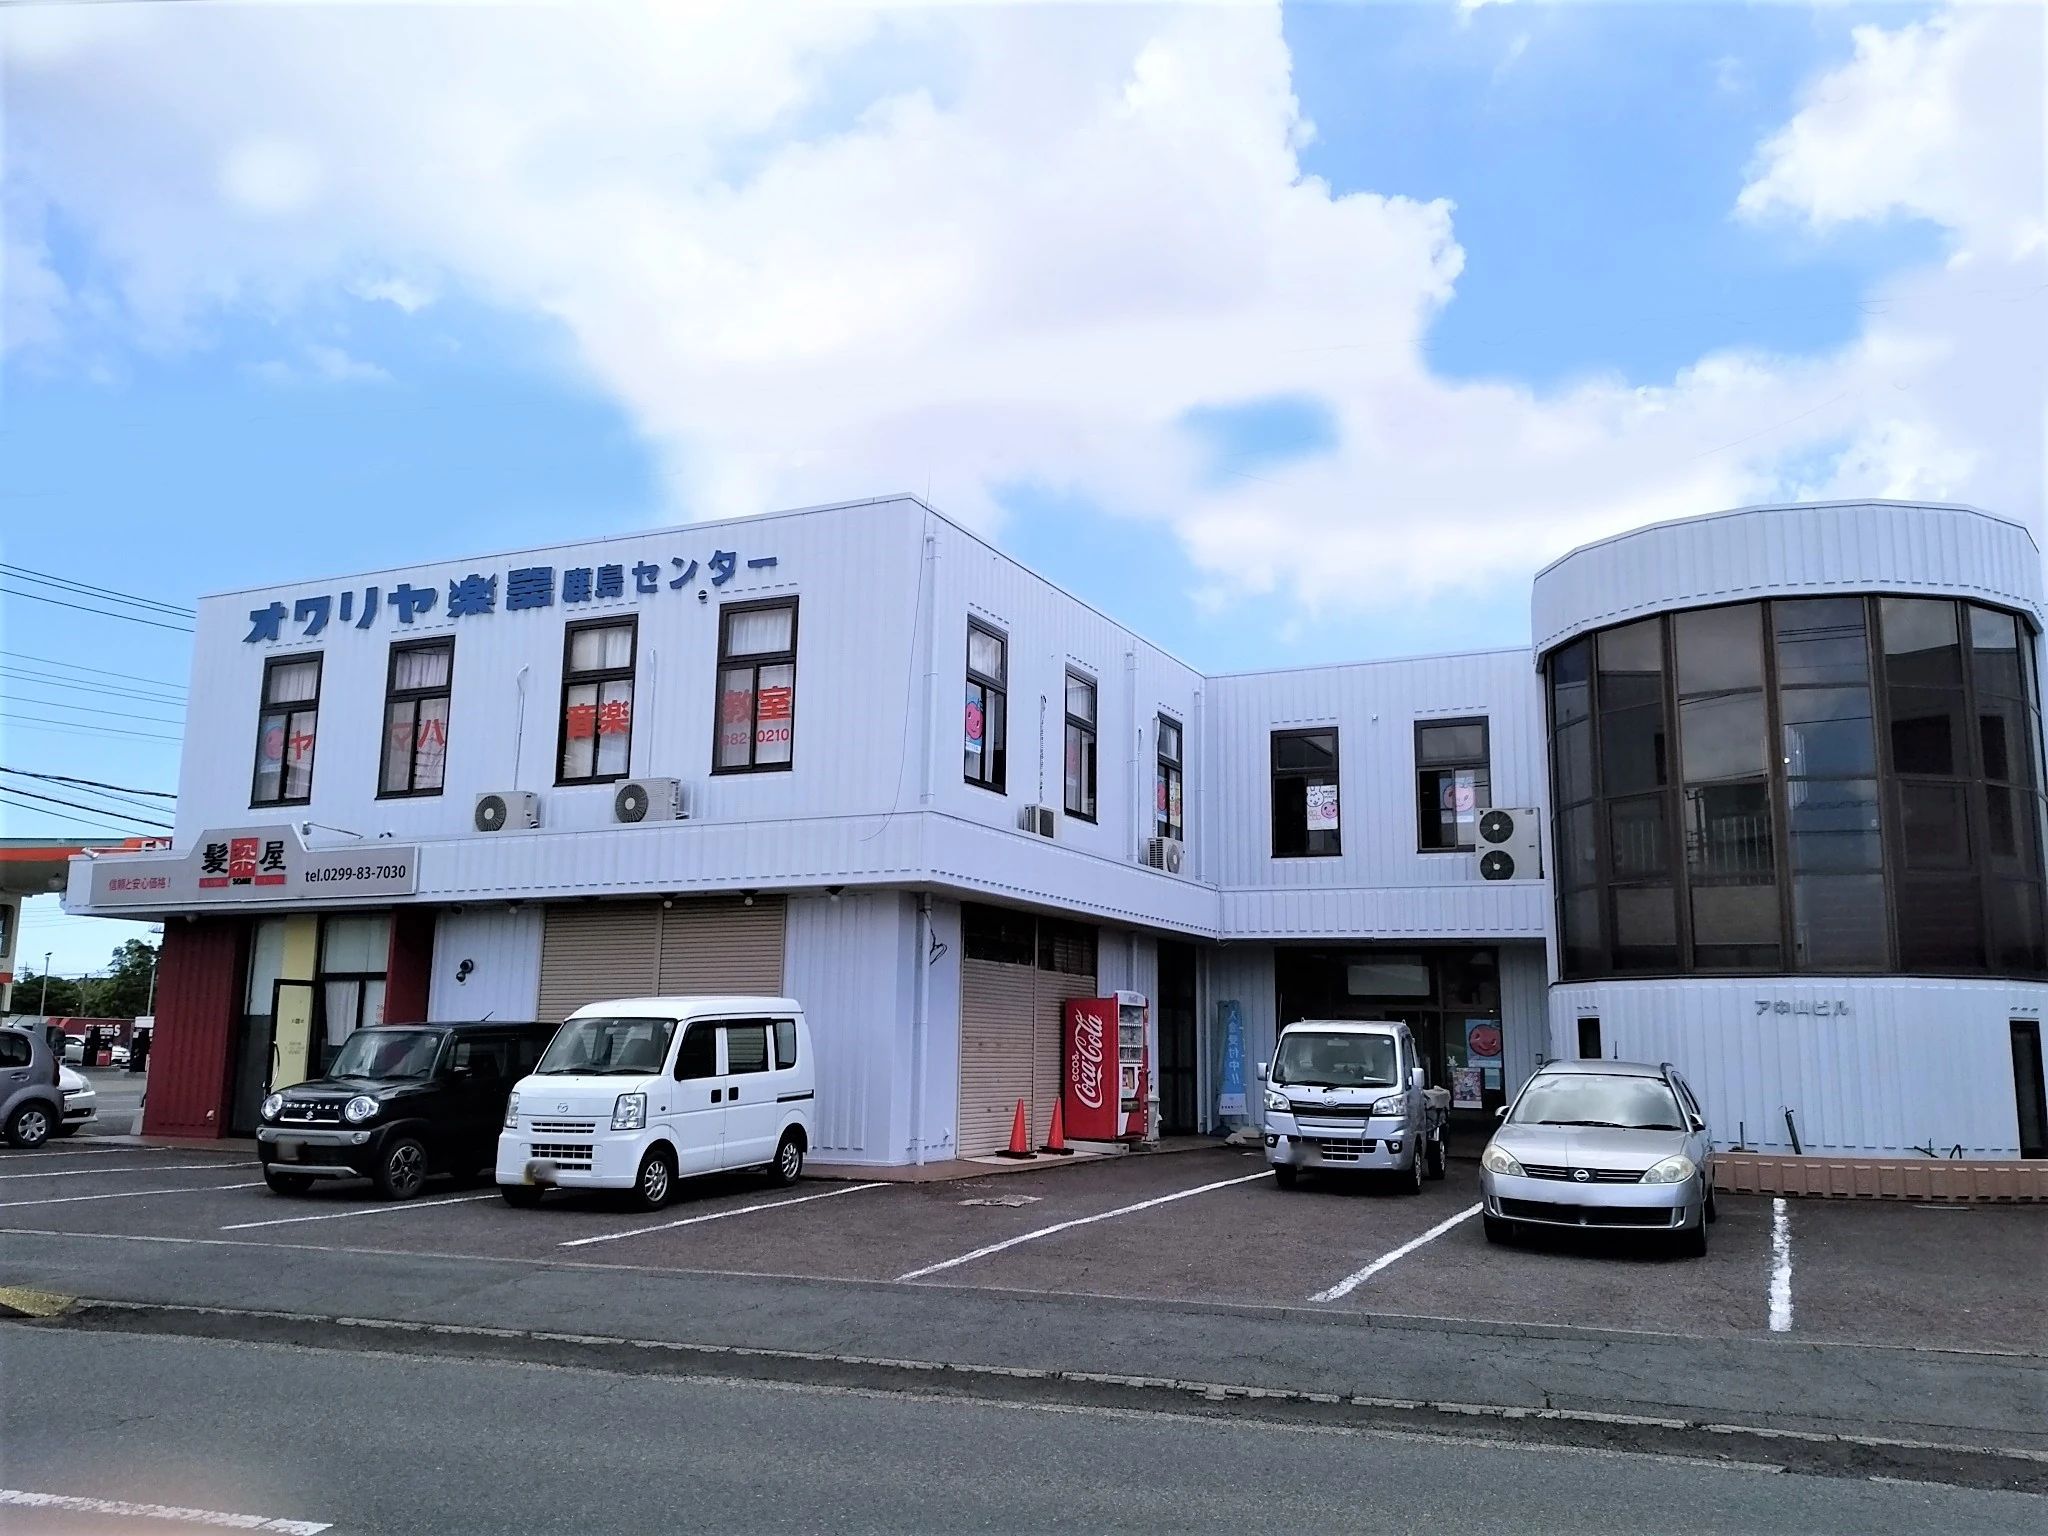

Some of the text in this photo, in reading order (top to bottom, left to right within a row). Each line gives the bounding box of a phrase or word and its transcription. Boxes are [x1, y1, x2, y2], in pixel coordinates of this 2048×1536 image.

[289, 731, 314, 760] ヤ
[566, 700, 629, 741] 音楽
[305, 865, 406, 883] tel.0299-83-7030
